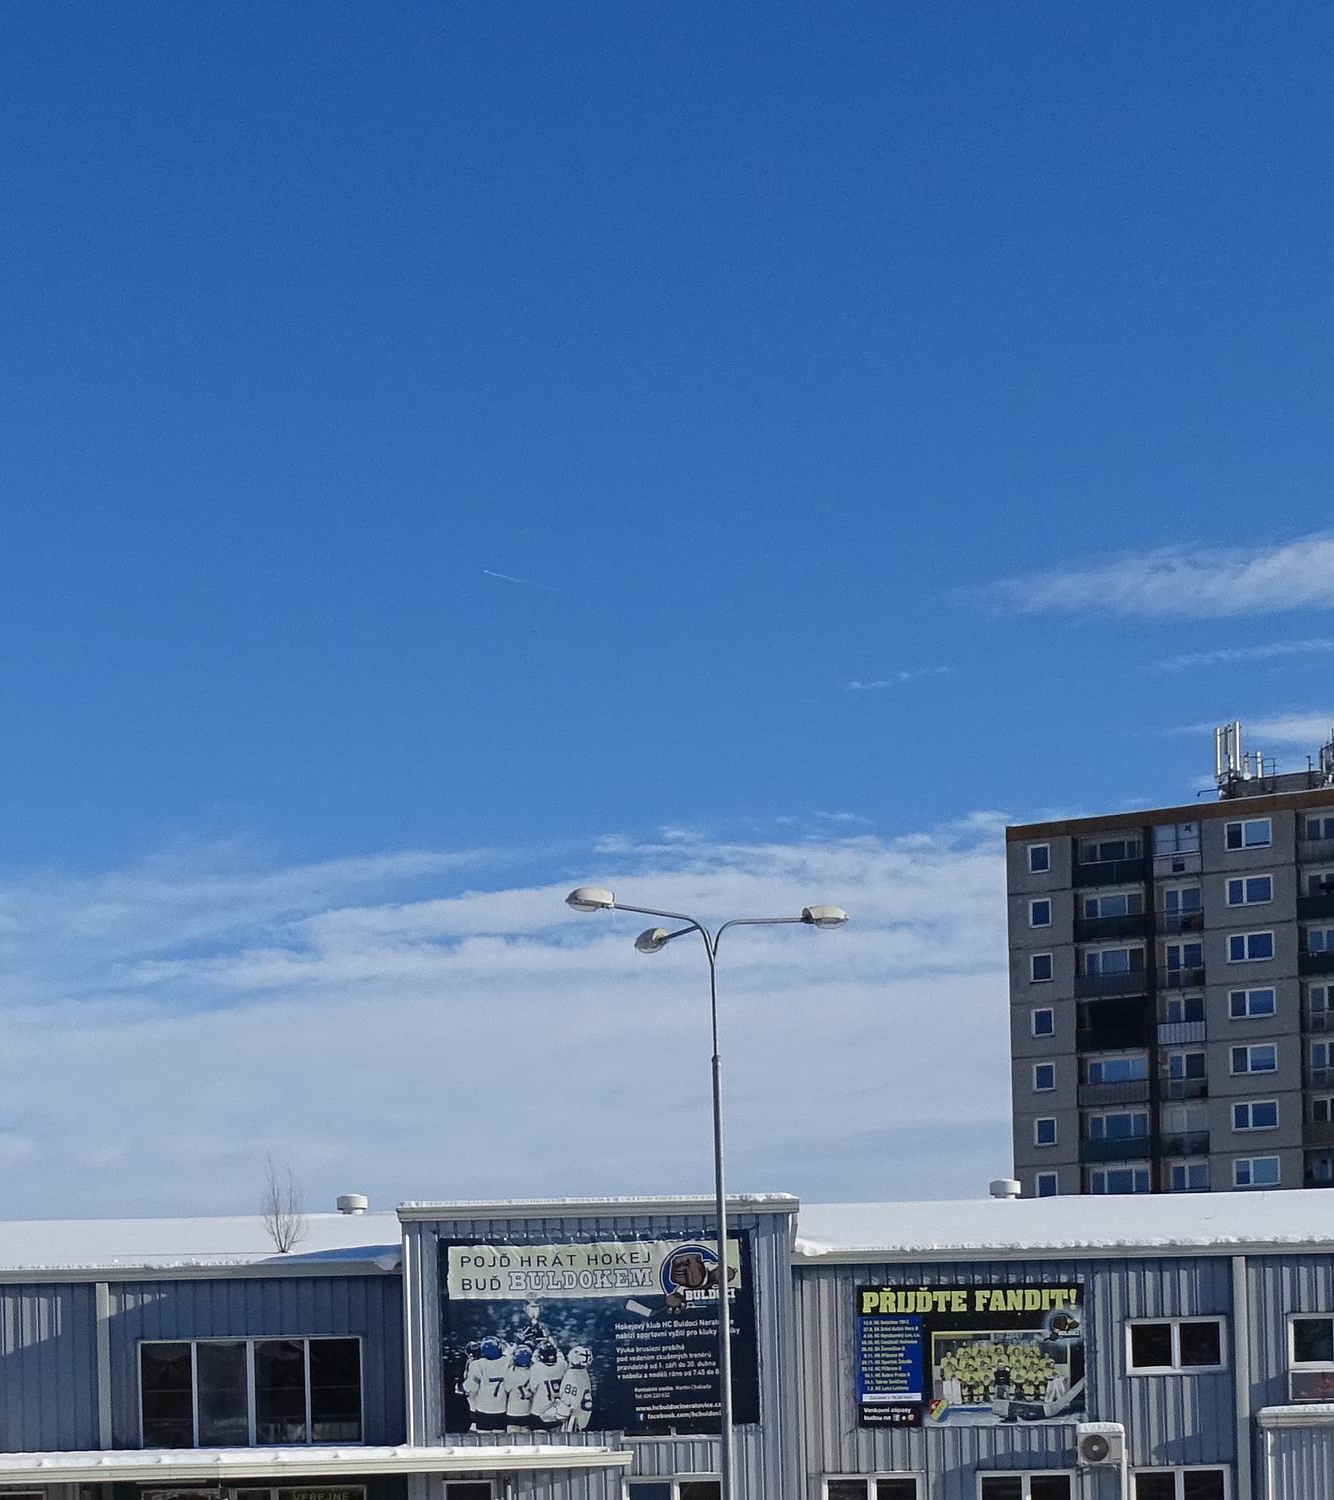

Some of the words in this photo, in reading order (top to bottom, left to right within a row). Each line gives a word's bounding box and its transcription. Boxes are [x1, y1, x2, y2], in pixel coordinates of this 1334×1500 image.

[460, 1253, 511, 1267] POJĎ
[520, 1251, 577, 1267] HRÁT
[587, 1252, 651, 1265] HOKEJ
[462, 1276, 501, 1291] BUĎ
[508, 1267, 653, 1290] BULDOKEM
[862, 1287, 967, 1313] PŘIJĎTE
[974, 1288, 1078, 1312] FANDIT!
[489, 1377, 504, 1397] 7
[564, 1384, 578, 1396] 88
